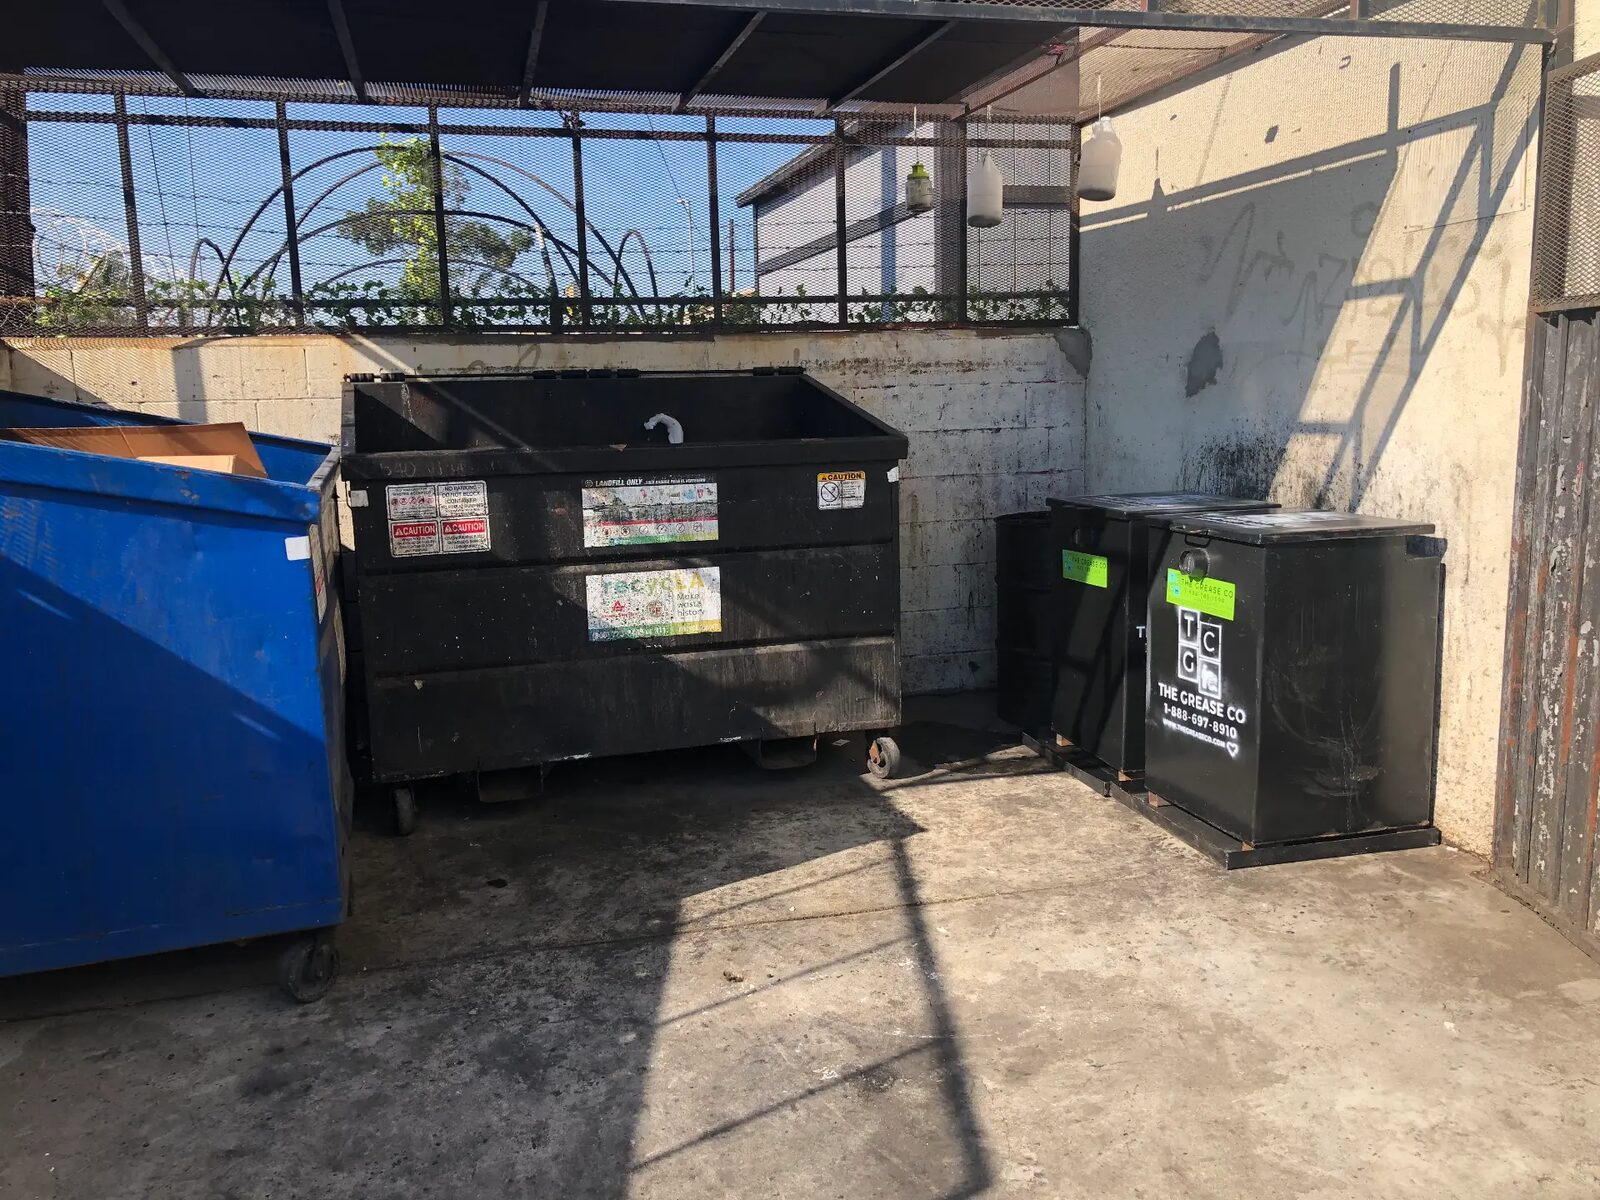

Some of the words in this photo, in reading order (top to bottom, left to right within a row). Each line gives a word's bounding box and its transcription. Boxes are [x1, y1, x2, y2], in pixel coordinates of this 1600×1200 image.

[828, 473, 862, 481] CAUTION
[402, 525, 436, 536] CAUTION
[451, 522, 485, 532] CAUTION
[1080, 557, 1097, 568] GREASE
[1181, 578, 1193, 589] THE
[1195, 581, 1221, 595] GREASE
[1223, 588, 1234, 599] CO
[677, 608, 705, 617] history
[1183, 614, 1194, 638] T
[1203, 631, 1215, 652] C
[1182, 650, 1194, 672] G
[1158, 682, 1178, 701] THE
[1180, 691, 1224, 718] GREASE
[1226, 706, 1246, 724] CO
[1163, 702, 1238, 739] 1-888-697-8910
